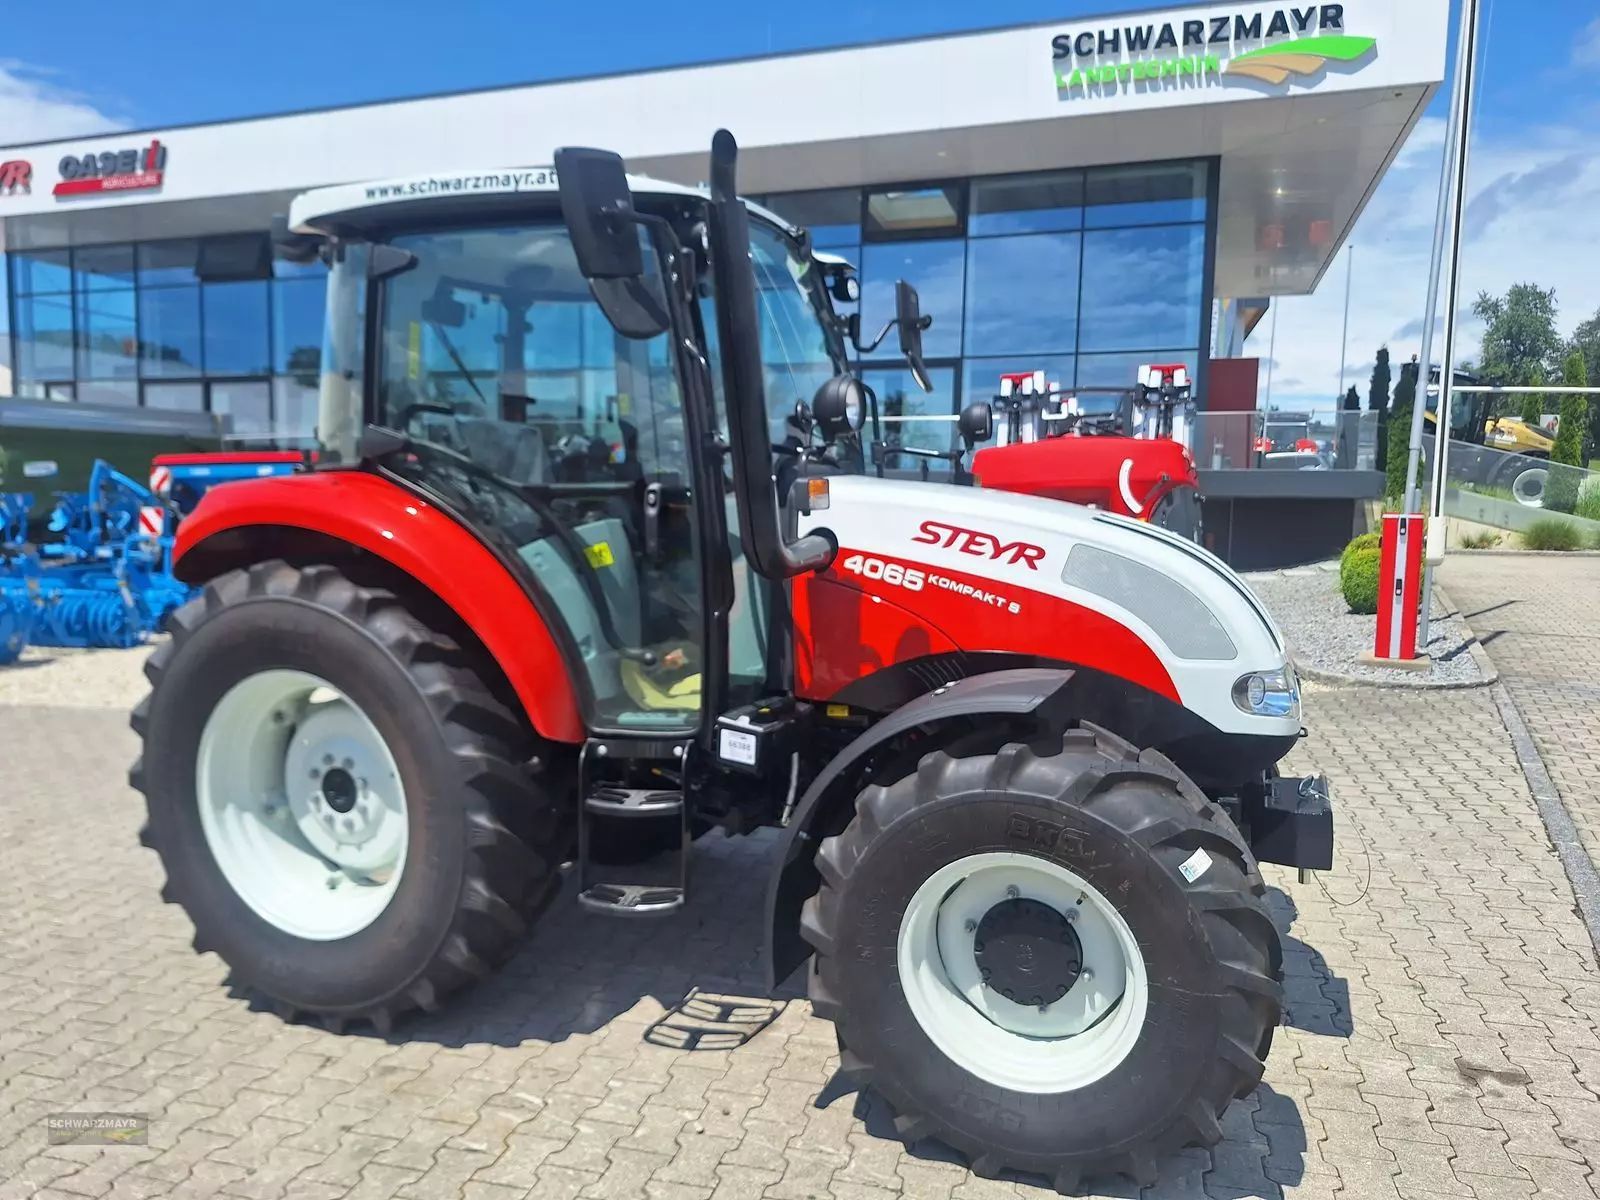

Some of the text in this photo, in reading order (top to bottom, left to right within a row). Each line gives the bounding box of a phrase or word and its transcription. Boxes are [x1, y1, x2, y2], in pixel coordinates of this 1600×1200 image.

[1051, 3, 1345, 59] SCHWARZMAYR
[1055, 54, 1221, 88] LANDTECHNIK
[58, 149, 138, 179] CASE
[365, 170, 557, 199] www.schwarzmayr.at
[911, 520, 1046, 571] STEYR
[843, 554, 926, 592] 4065
[927, 573, 1006, 607] KOMPAKT
